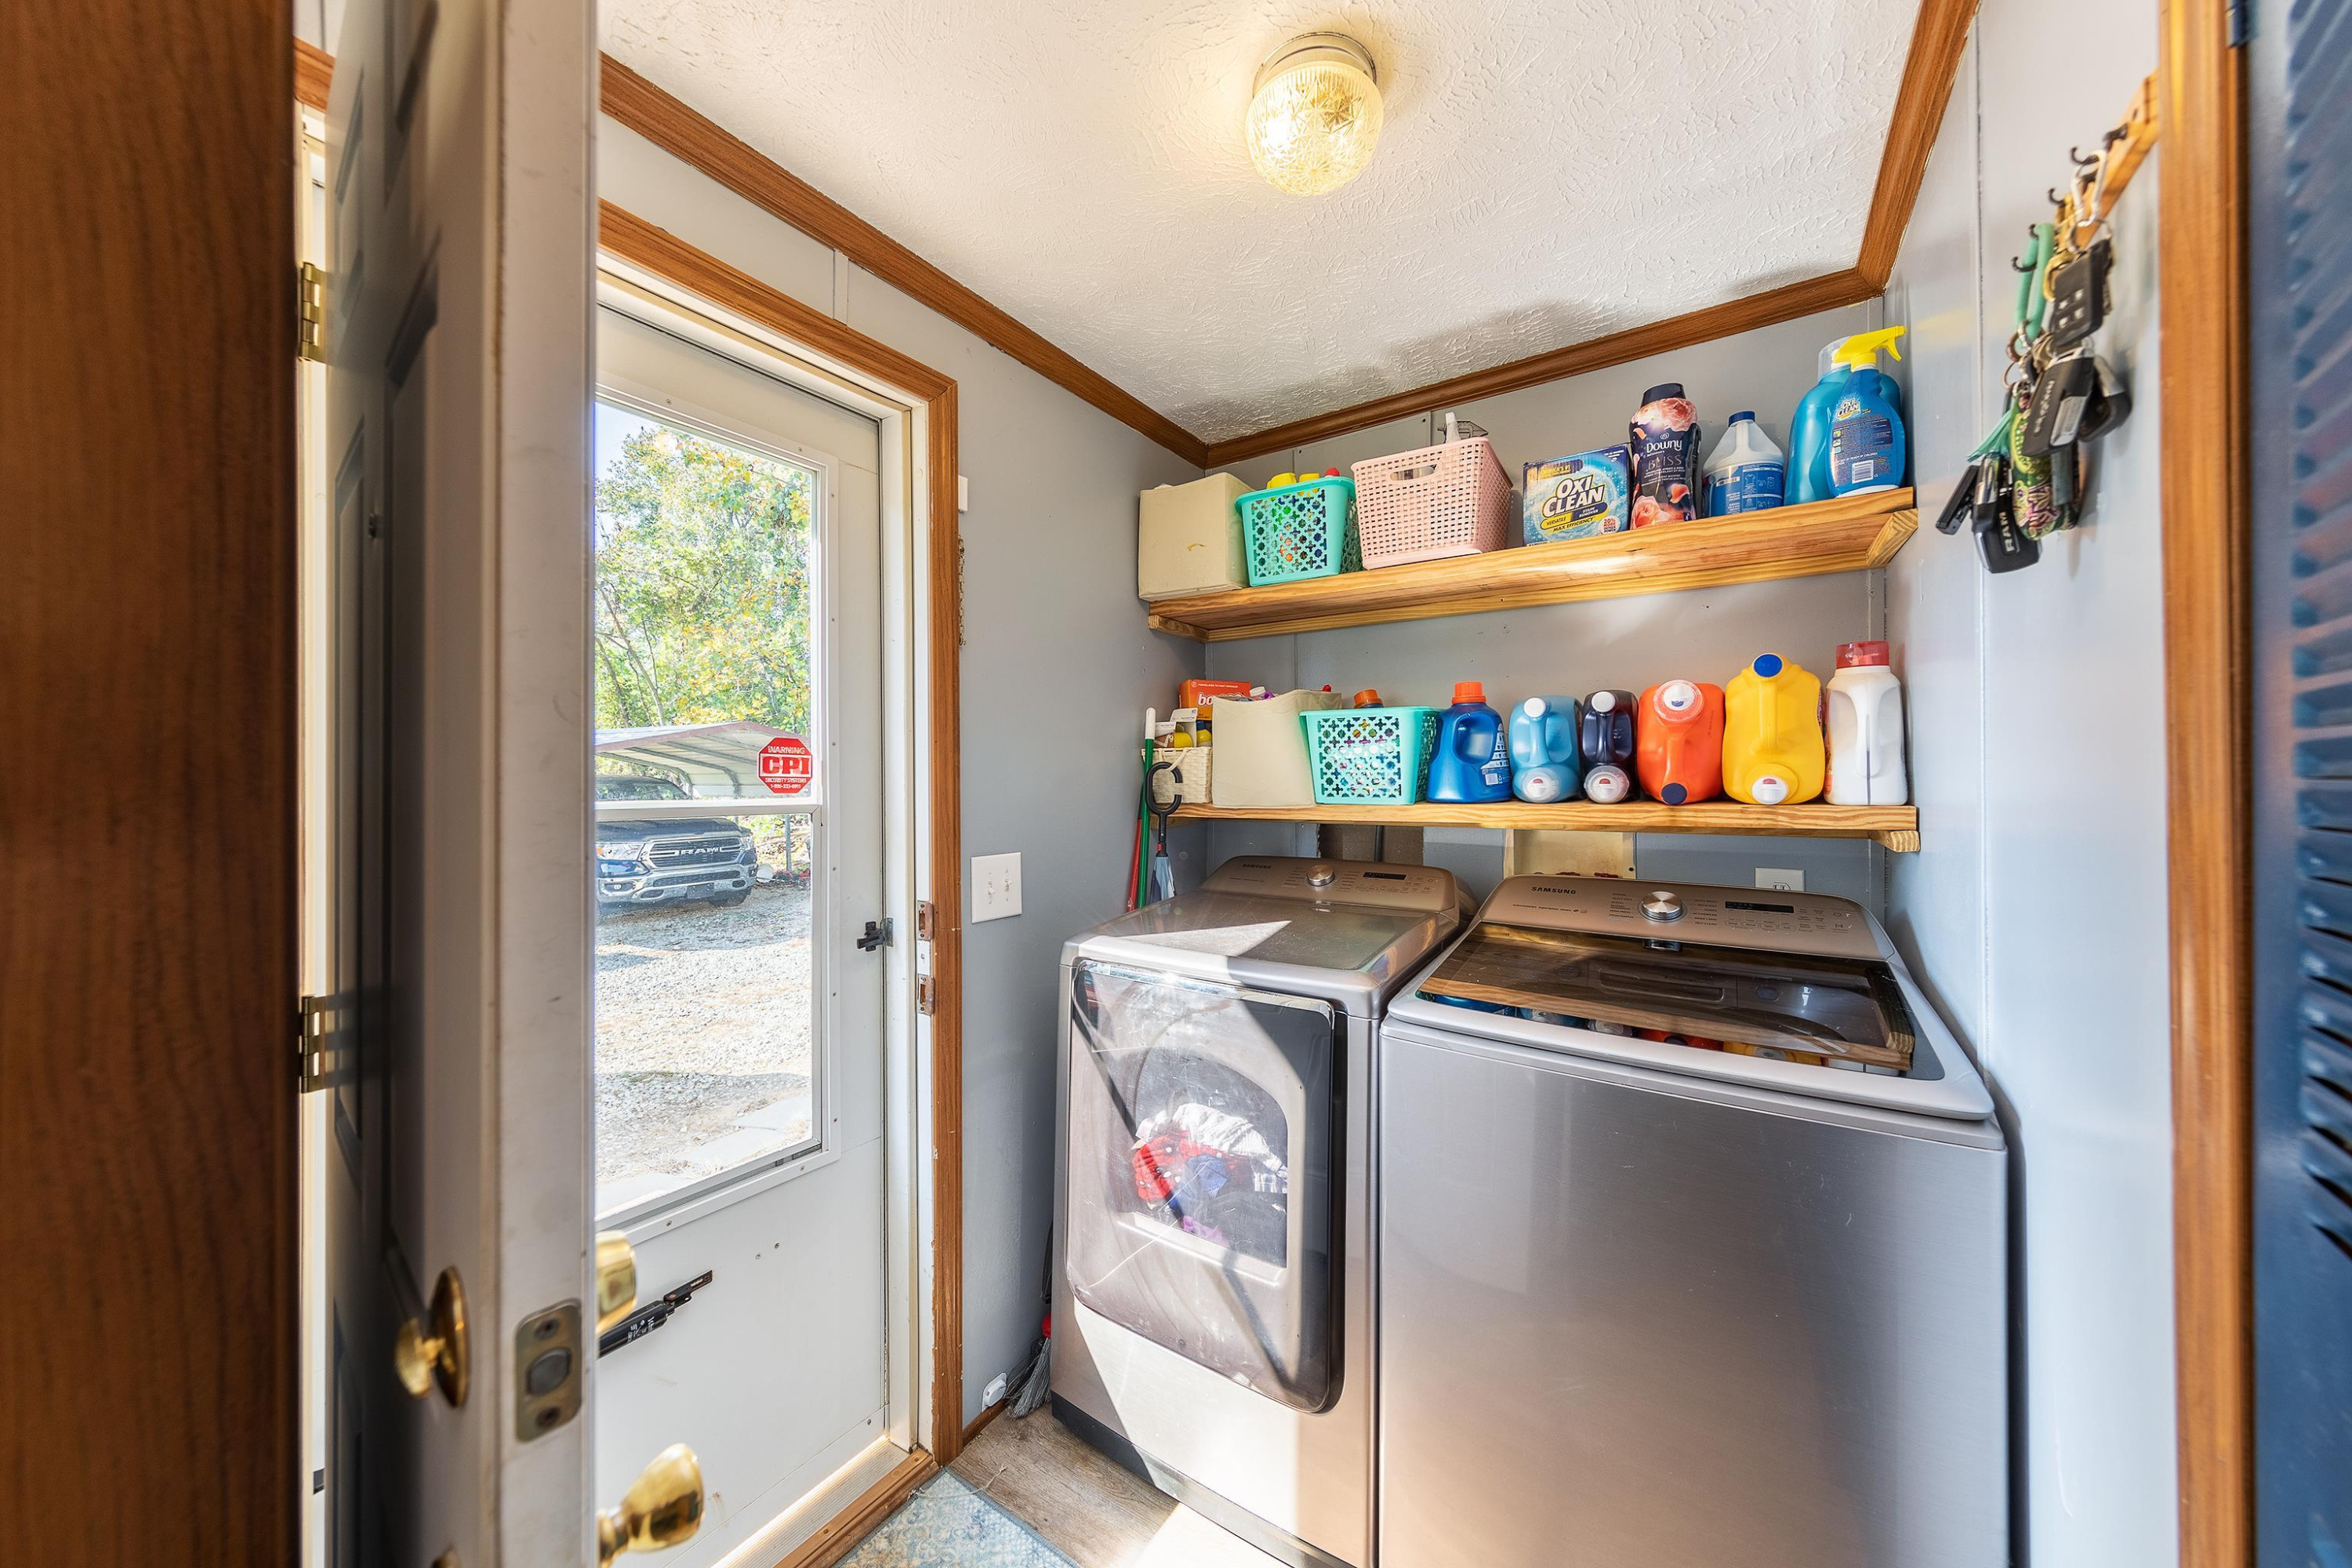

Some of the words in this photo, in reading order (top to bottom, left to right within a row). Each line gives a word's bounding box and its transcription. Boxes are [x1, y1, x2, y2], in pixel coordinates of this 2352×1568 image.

[1646, 440, 1682, 453] Downy
[1648, 456, 1682, 470] BLISS
[1556, 475, 1593, 499] OXI
[1542, 485, 1605, 517] CLEAN
[1579, 509, 1599, 517] REMOVER
[1547, 517, 1566, 525] VERSATILE
[1566, 518, 1594, 528] EFFICIENCY
[2000, 511, 2015, 552] RAM
[768, 746, 805, 754] WARNING
[762, 757, 809, 774] CPI
[1531, 886, 1577, 895] SAMSUNG
